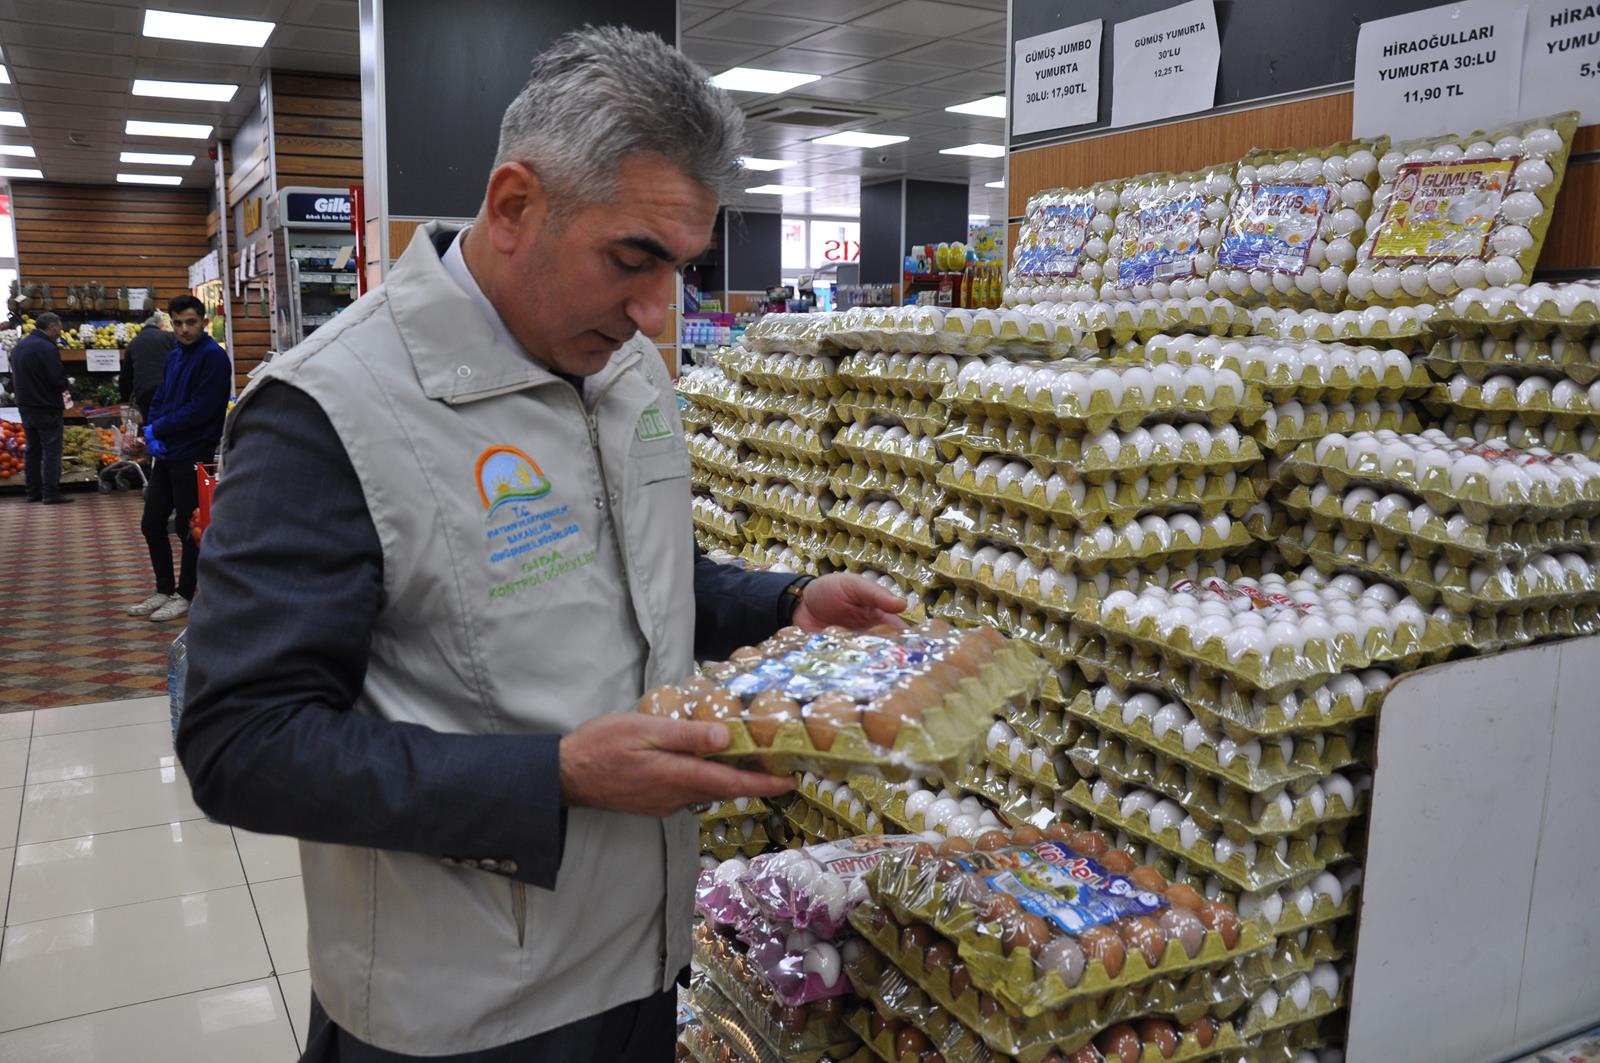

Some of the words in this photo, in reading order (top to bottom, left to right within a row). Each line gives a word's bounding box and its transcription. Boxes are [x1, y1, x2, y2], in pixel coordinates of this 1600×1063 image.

[1550, 4, 1600, 27] HİRA
[1135, 33, 1164, 47] GÜMÜŞ
[1166, 22, 1206, 40] YUMURTA
[1383, 25, 1494, 57] HİRAOĞULLARI
[1025, 47, 1056, 63] GÜMÜŞ
[1058, 39, 1092, 56] JUMBO
[1035, 62, 1078, 80] YUMURTA
[1154, 66, 1173, 78] 12,25
[1174, 64, 1184, 73] TL
[1379, 60, 1449, 81] YUMURTA
[1580, 60, 1600, 78] 5,
[1052, 83, 1087, 99] 17,90TL
[1404, 87, 1441, 104] 11,90
[1446, 84, 1464, 97] TL
